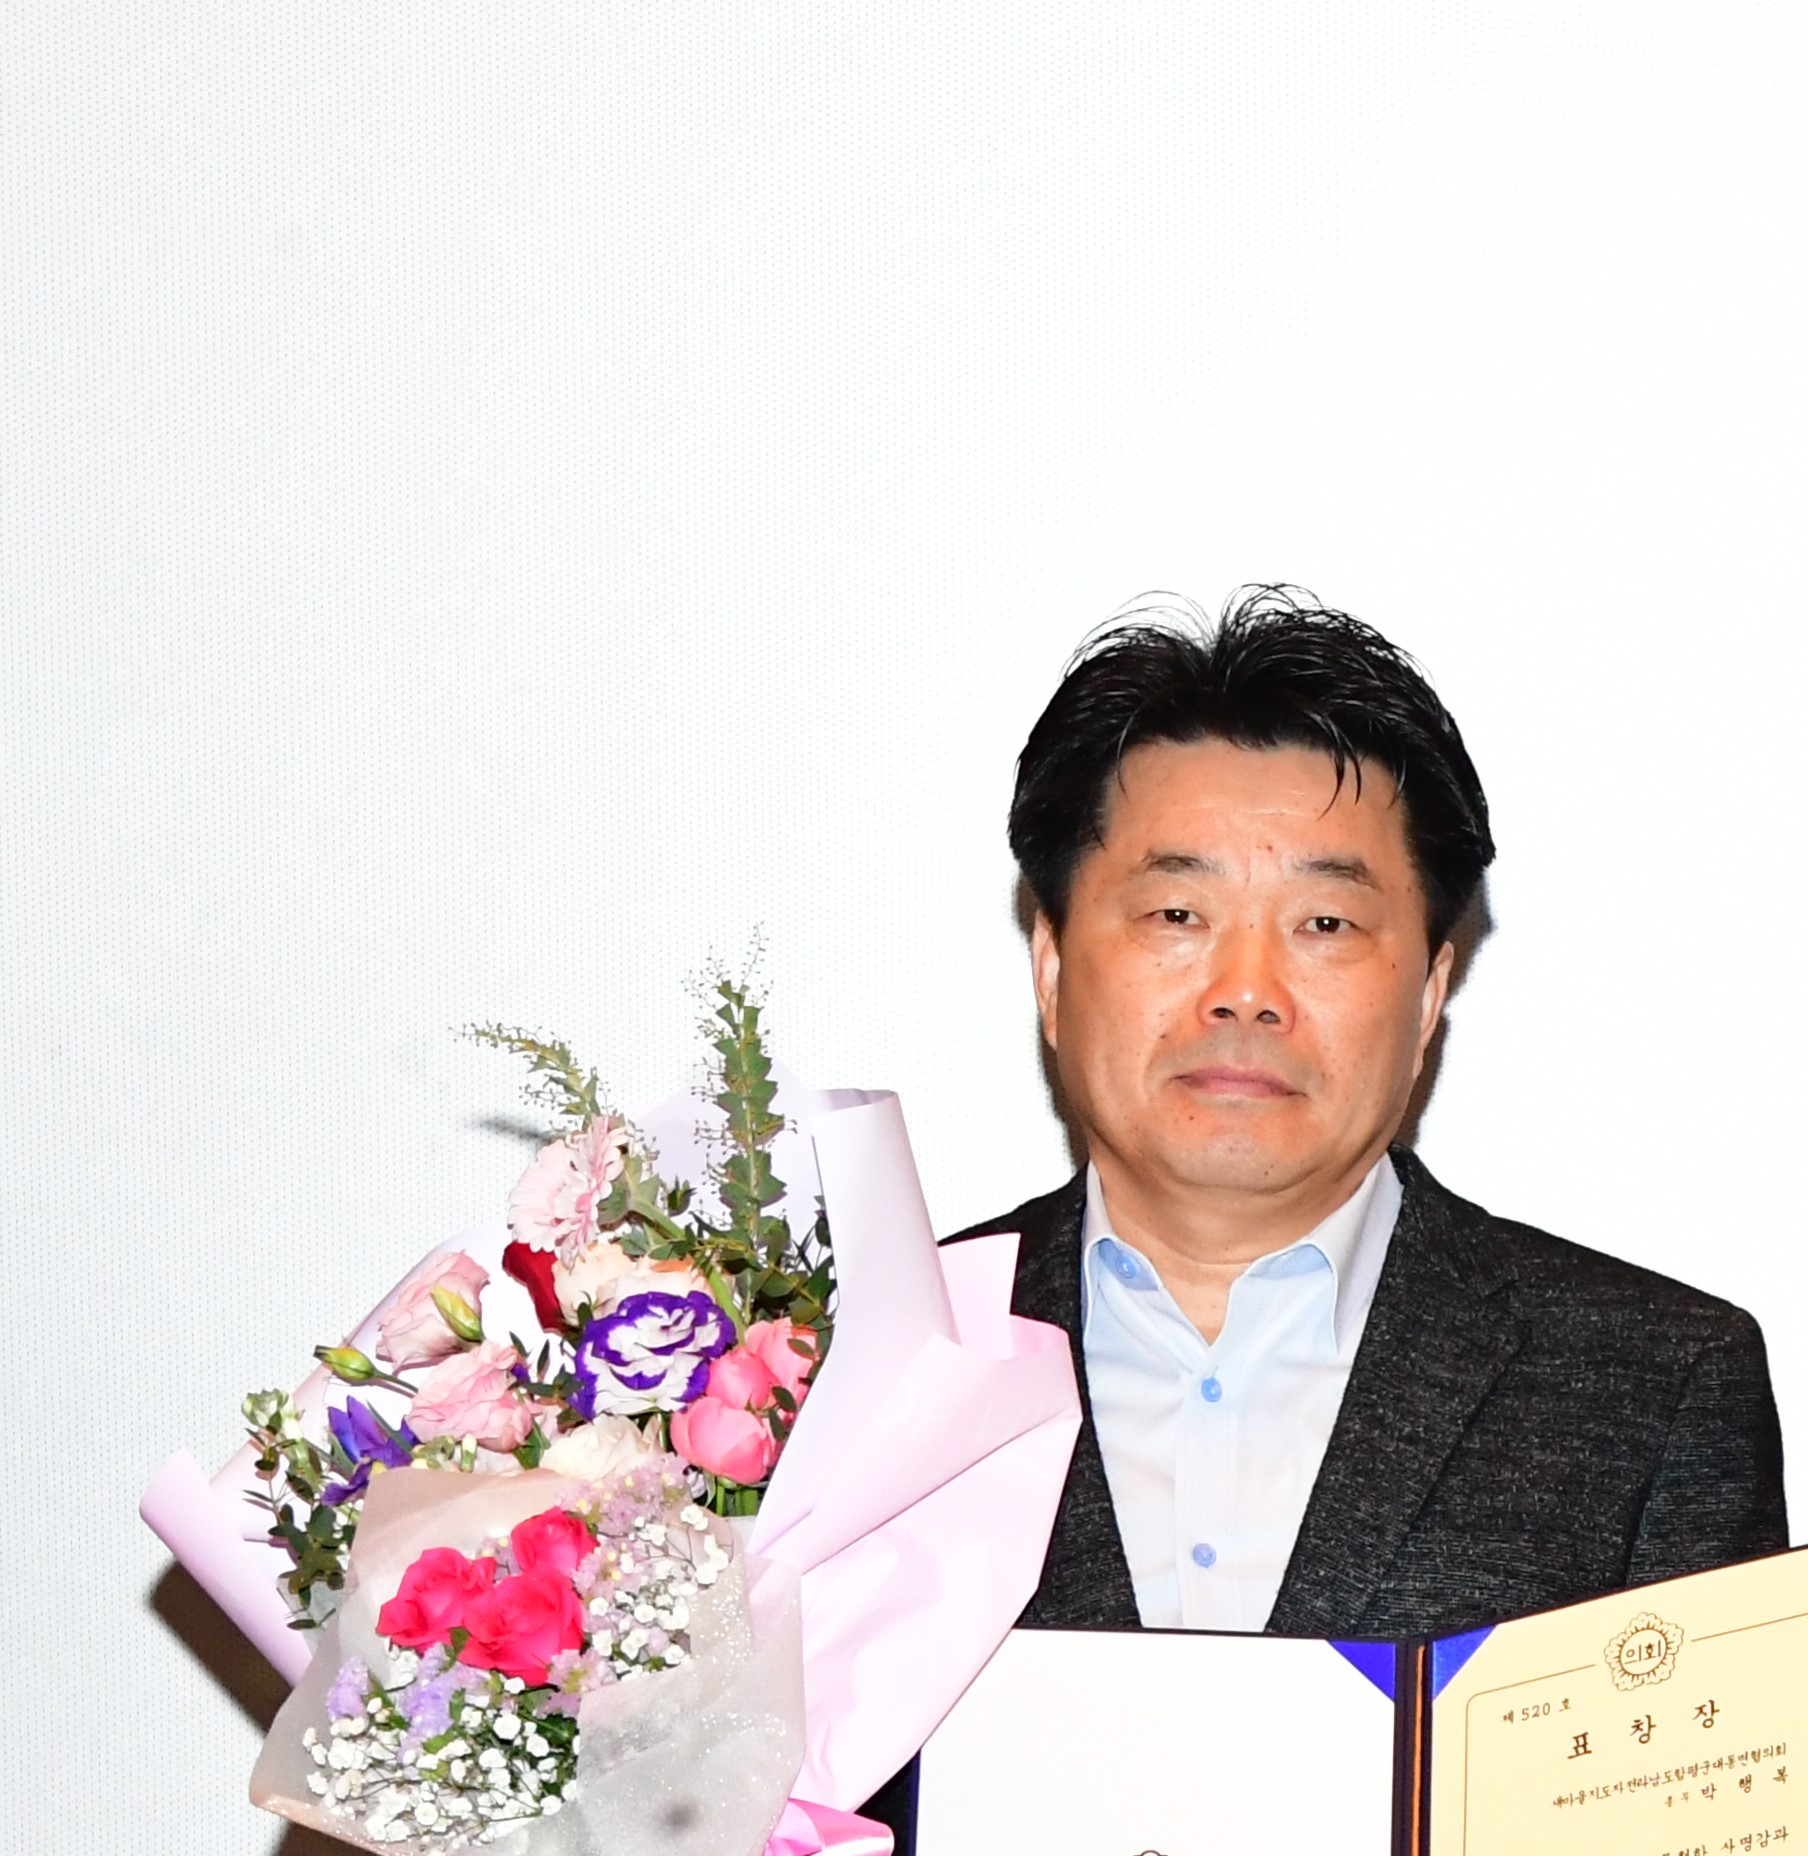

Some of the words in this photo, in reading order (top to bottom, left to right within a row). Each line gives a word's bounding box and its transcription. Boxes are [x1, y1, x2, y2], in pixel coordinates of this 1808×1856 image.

[1623, 1640, 1662, 1665] 의회
[1521, 1701, 1550, 1721] 520
[1566, 1731, 1592, 1759] 표
[1630, 1714, 1656, 1744] 창
[1692, 1699, 1720, 1728] 장
[1720, 1825, 1789, 1853] 사명감과
